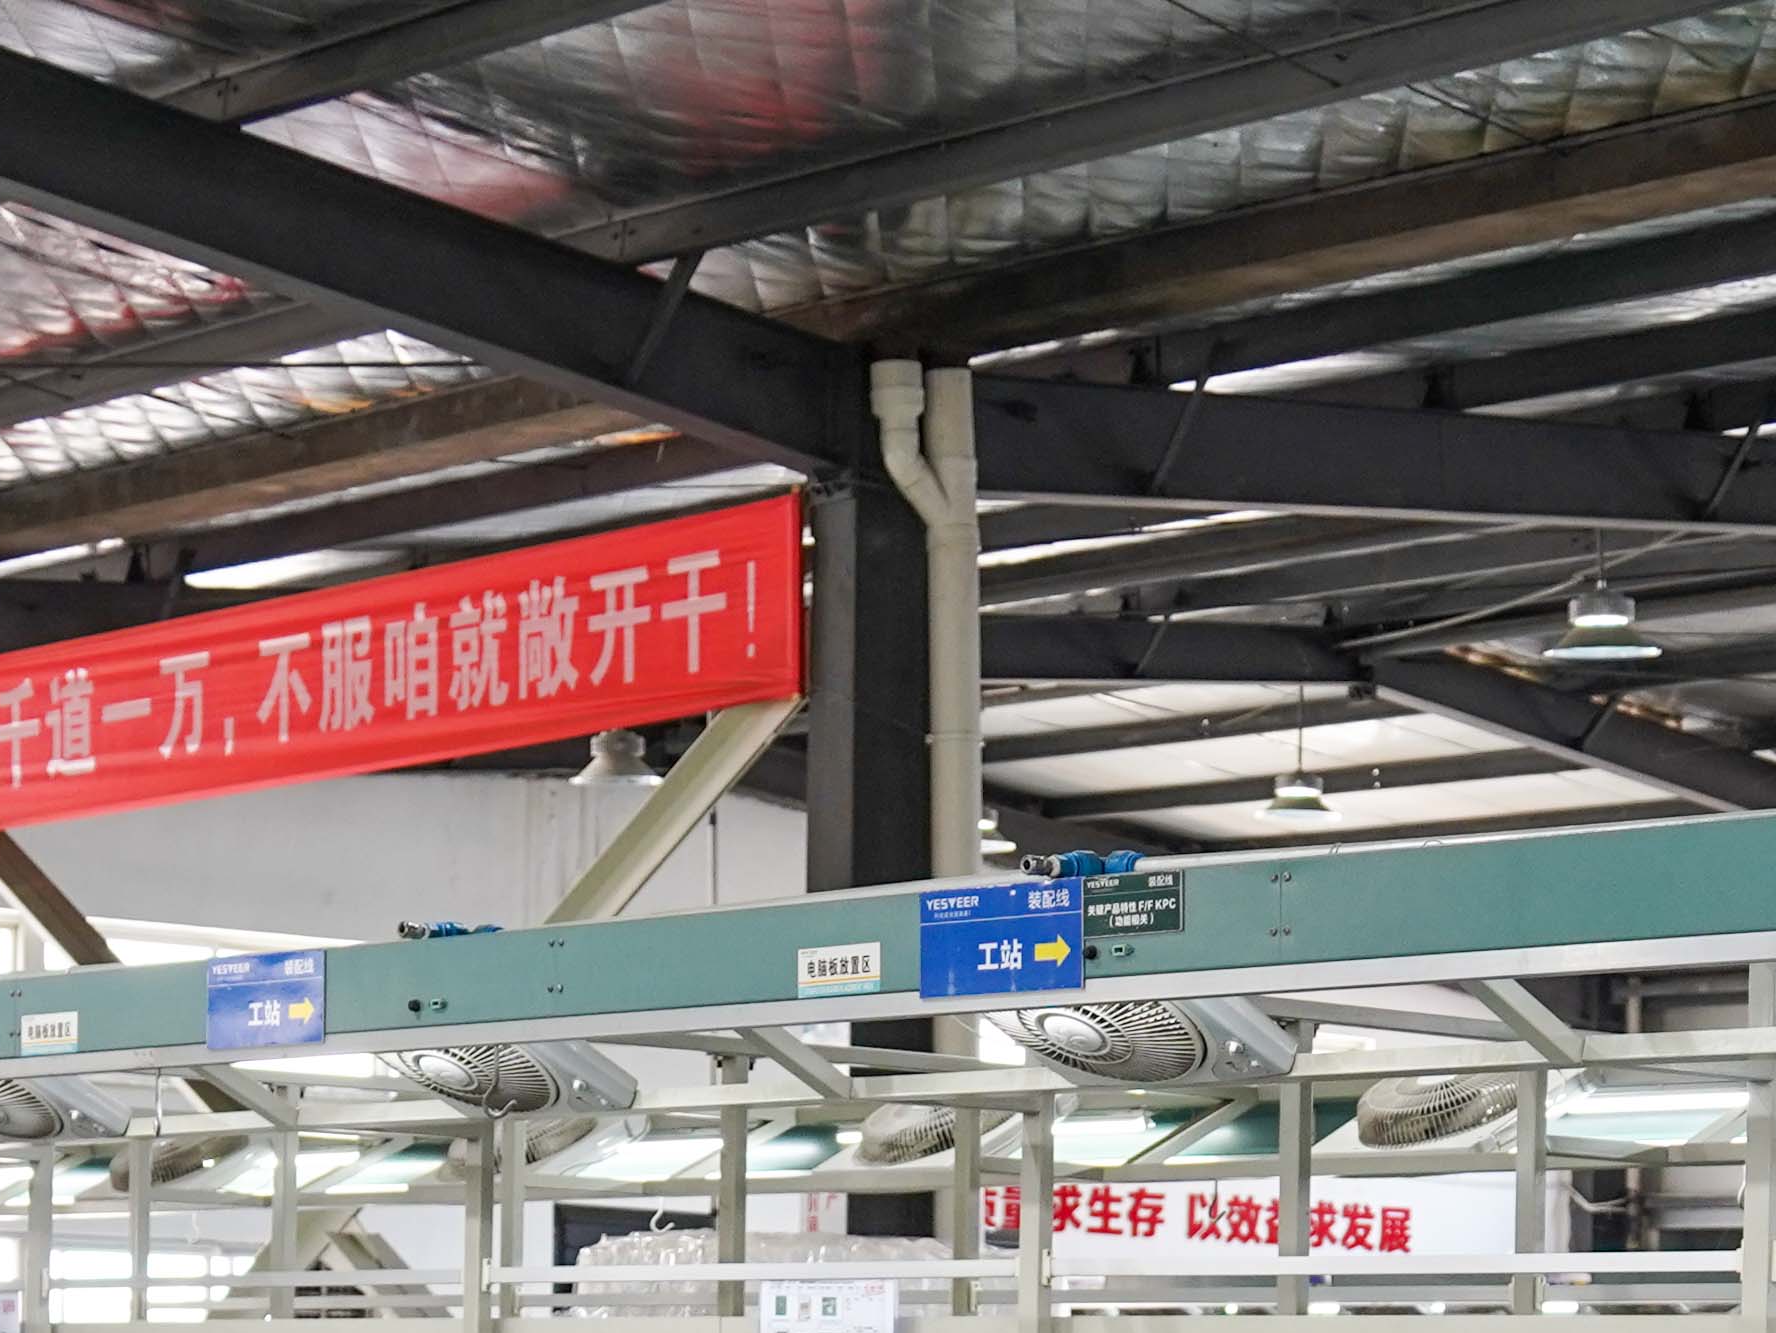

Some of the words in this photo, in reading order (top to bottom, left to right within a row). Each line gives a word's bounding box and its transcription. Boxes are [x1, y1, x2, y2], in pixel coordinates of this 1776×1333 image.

[926, 895, 980, 911] YESVEER
[1028, 890, 1071, 910] 装配线
[1155, 898, 1177, 910] KPC
[976, 938, 1023, 971] 工站
[247, 1000, 281, 1027] 工站
